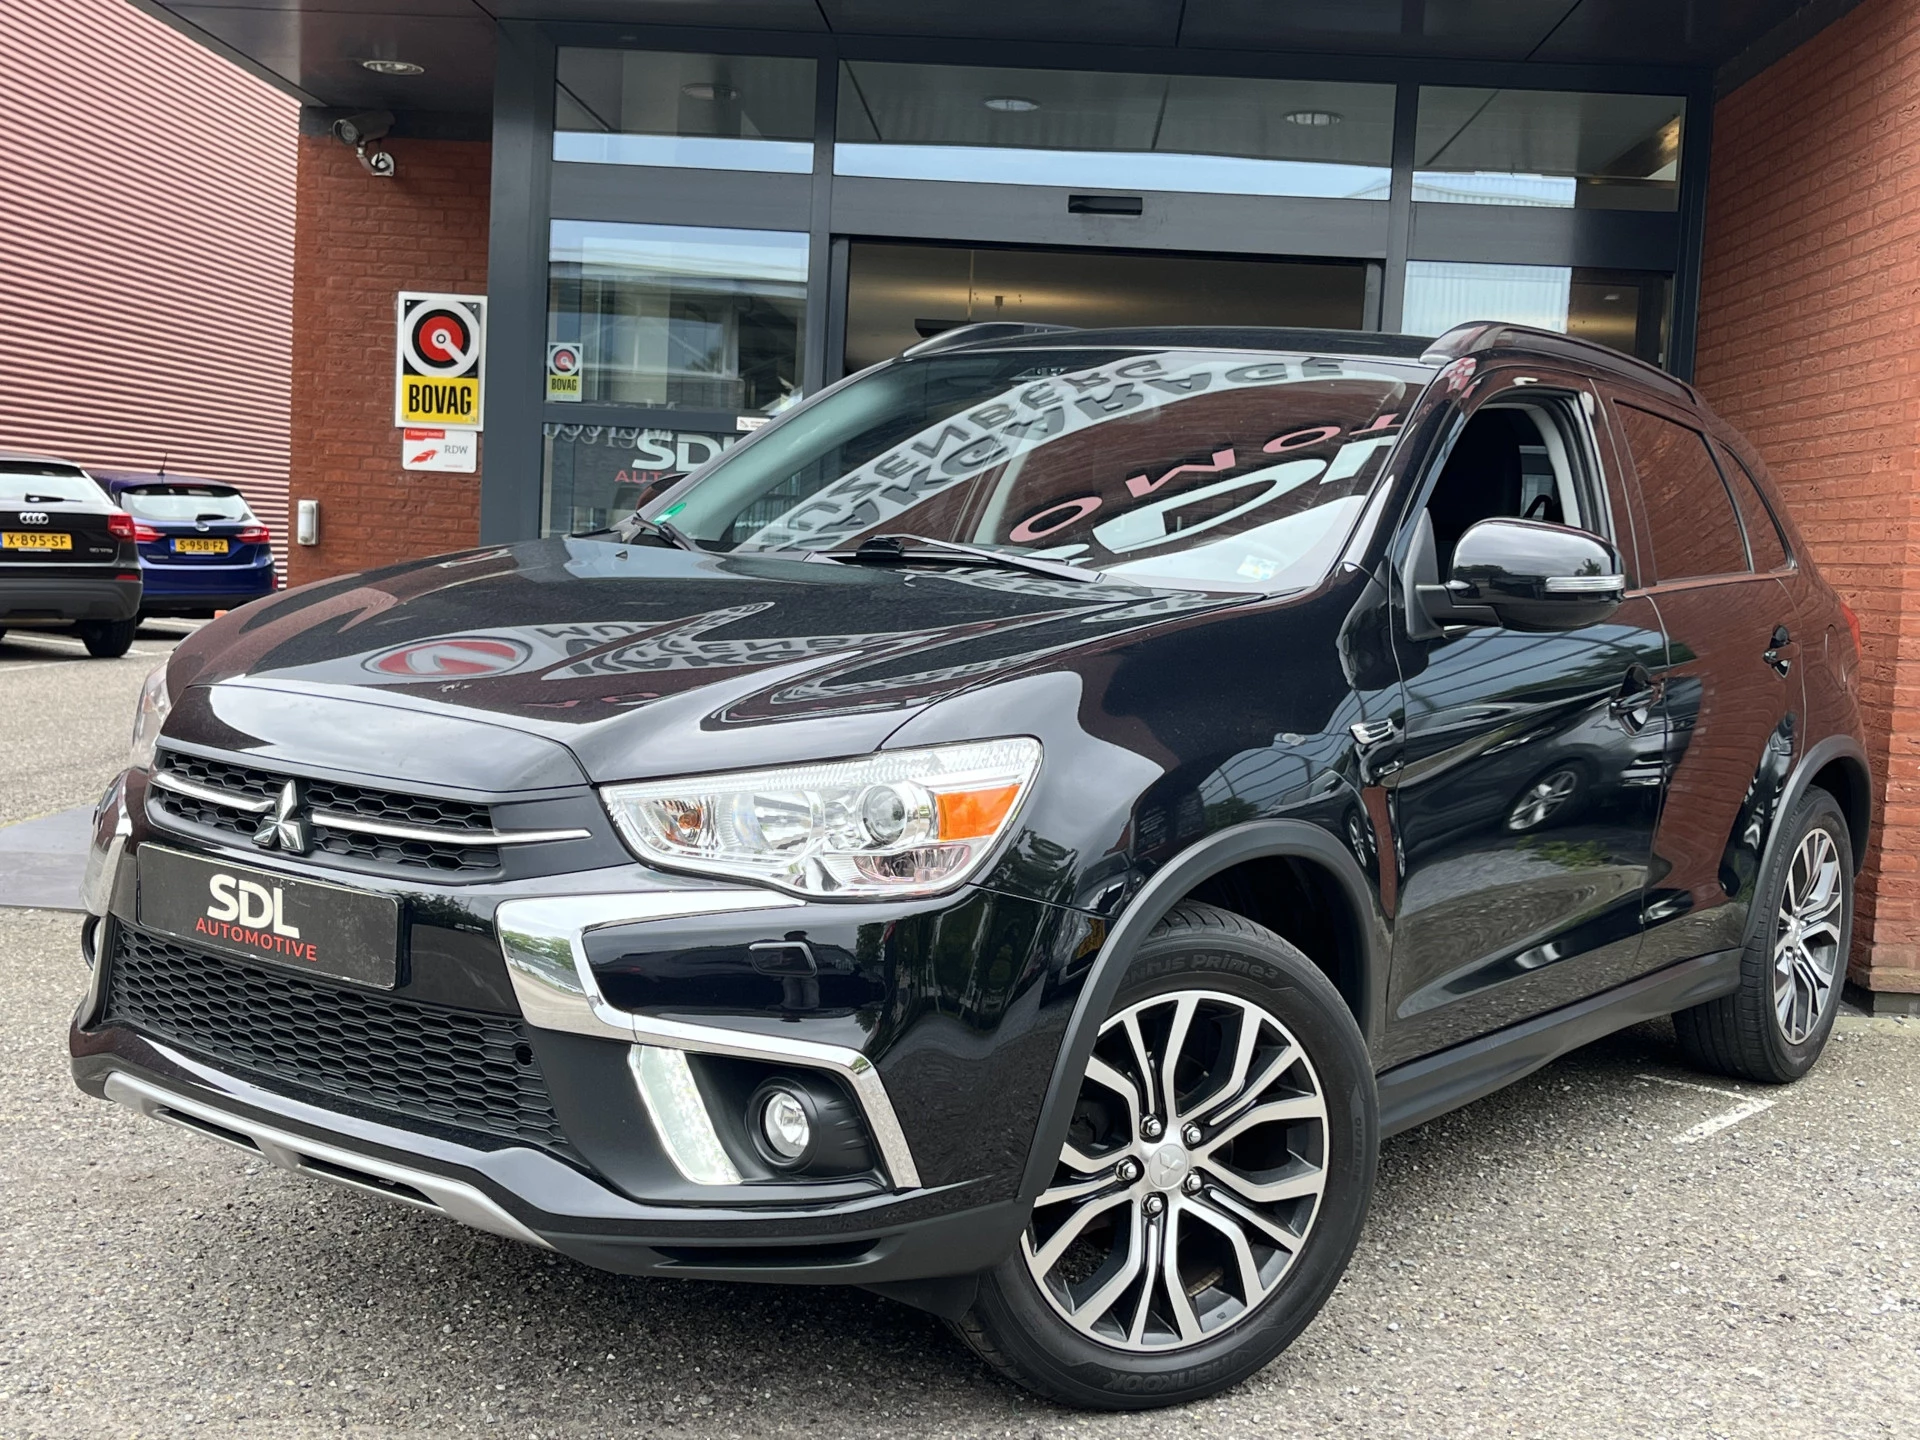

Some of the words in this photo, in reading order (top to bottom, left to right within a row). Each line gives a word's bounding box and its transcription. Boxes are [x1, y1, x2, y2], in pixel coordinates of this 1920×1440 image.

[551, 378, 577, 391] BOVAG
[408, 384, 472, 415] BOVAG
[444, 444, 468, 455] RDW
[614, 470, 663, 484] AUT
[7, 534, 67, 547] X-895-SF
[179, 540, 225, 551] S-958-FZ
[206, 873, 300, 939] SDL
[195, 917, 318, 962] AUTOMOTIVE
